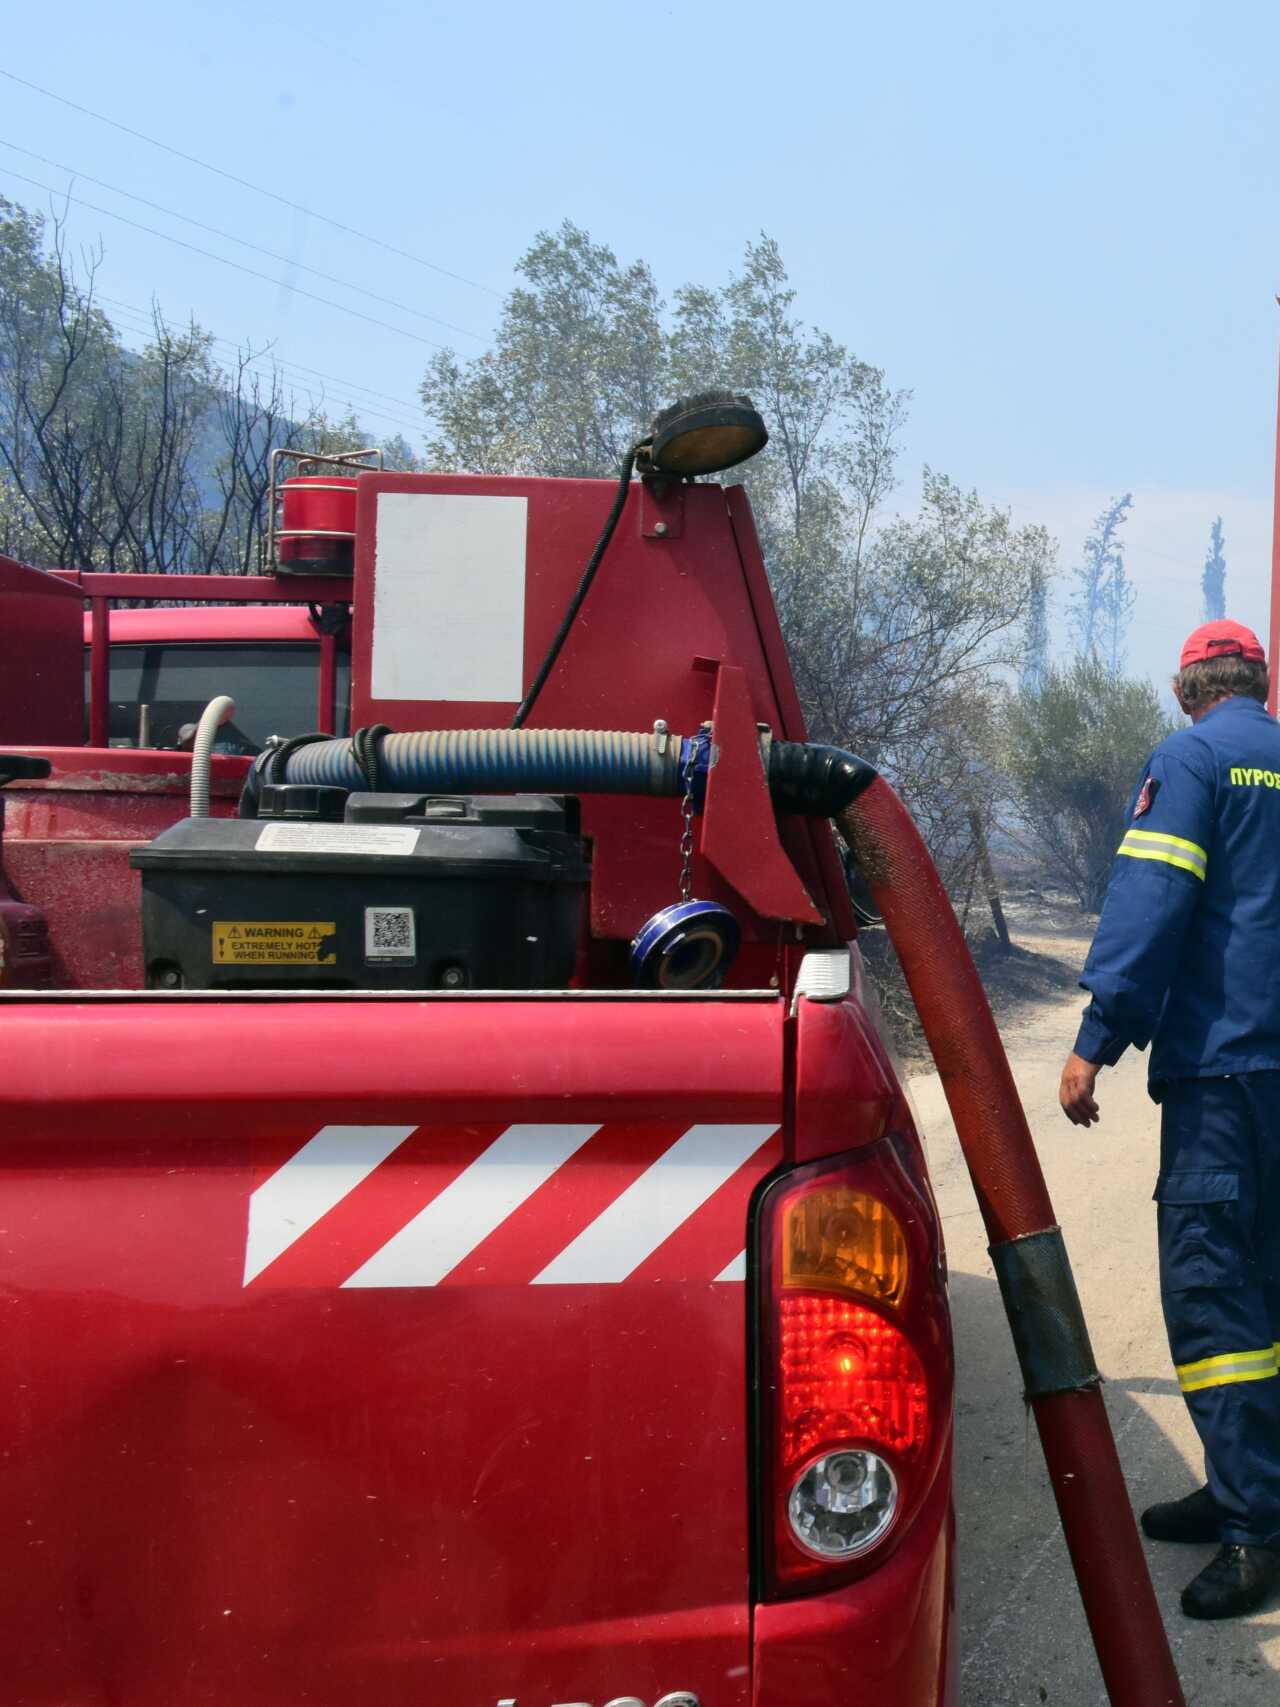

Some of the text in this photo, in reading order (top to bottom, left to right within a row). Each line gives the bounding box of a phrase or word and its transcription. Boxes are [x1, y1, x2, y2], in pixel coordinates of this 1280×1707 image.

[244, 927, 304, 938] WARNING
[231, 942, 317, 950] EXTREMELY HOT
[233, 951, 317, 960] WHEN RUNNING
